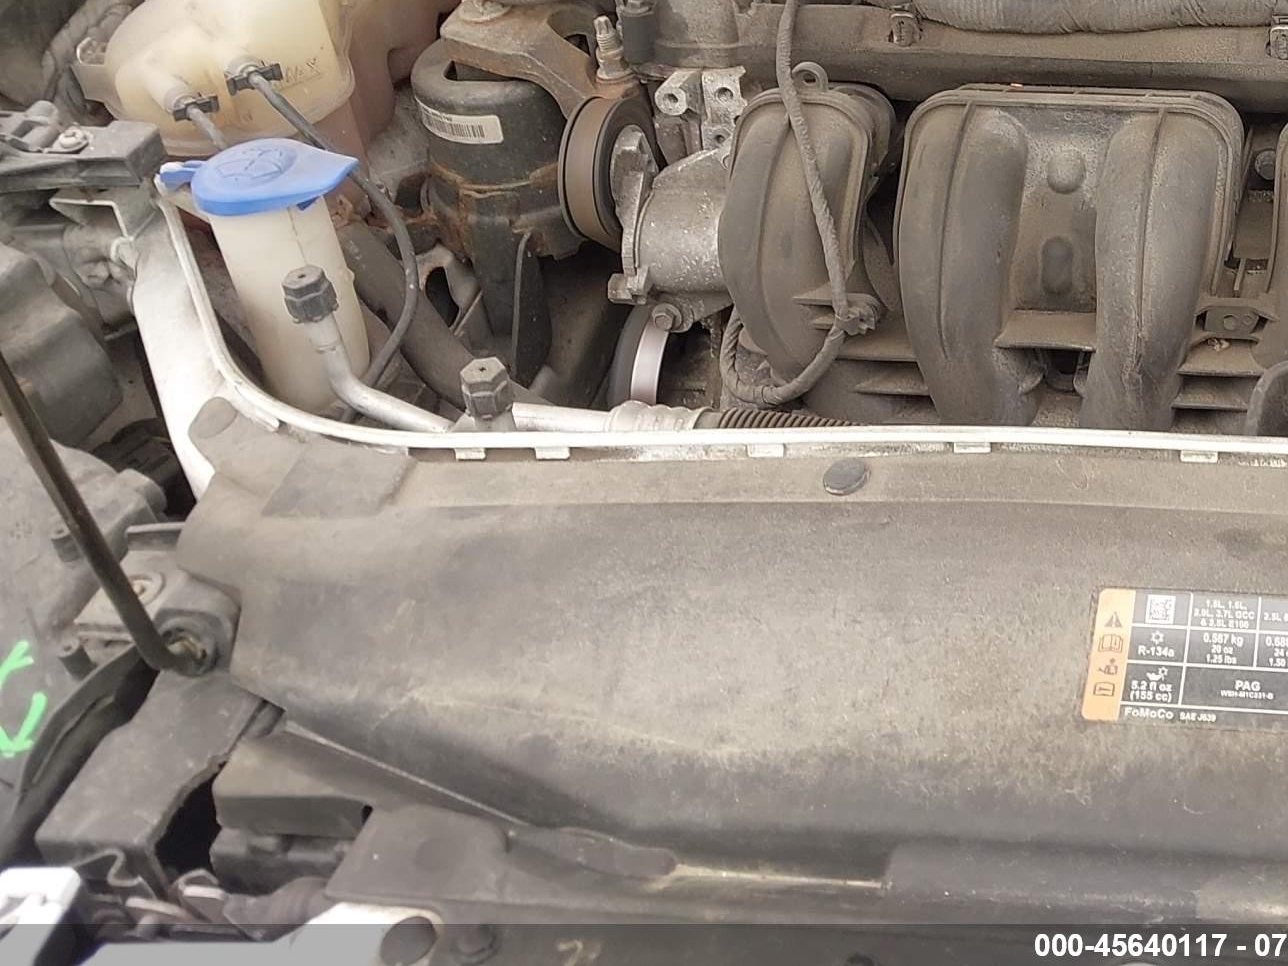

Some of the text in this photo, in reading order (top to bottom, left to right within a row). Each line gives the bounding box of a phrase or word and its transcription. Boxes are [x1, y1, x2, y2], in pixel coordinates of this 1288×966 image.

[1231, 634, 1244, 647] kg
[1137, 645, 1175, 658] R-134a
[1211, 645, 1233, 655] 20 oz
[1273, 648, 1284, 658] 24
[1206, 654, 1237, 664] 1.25 lbs
[1268, 657, 1286, 668] 1.50
[1131, 680, 1173, 692] 5.2 fl oz
[1235, 679, 1261, 692] PAG
[1130, 690, 1172, 703] (155 cc)
[1124, 707, 1174, 720] FoMoCo
[1180, 711, 1197, 721] SAE
